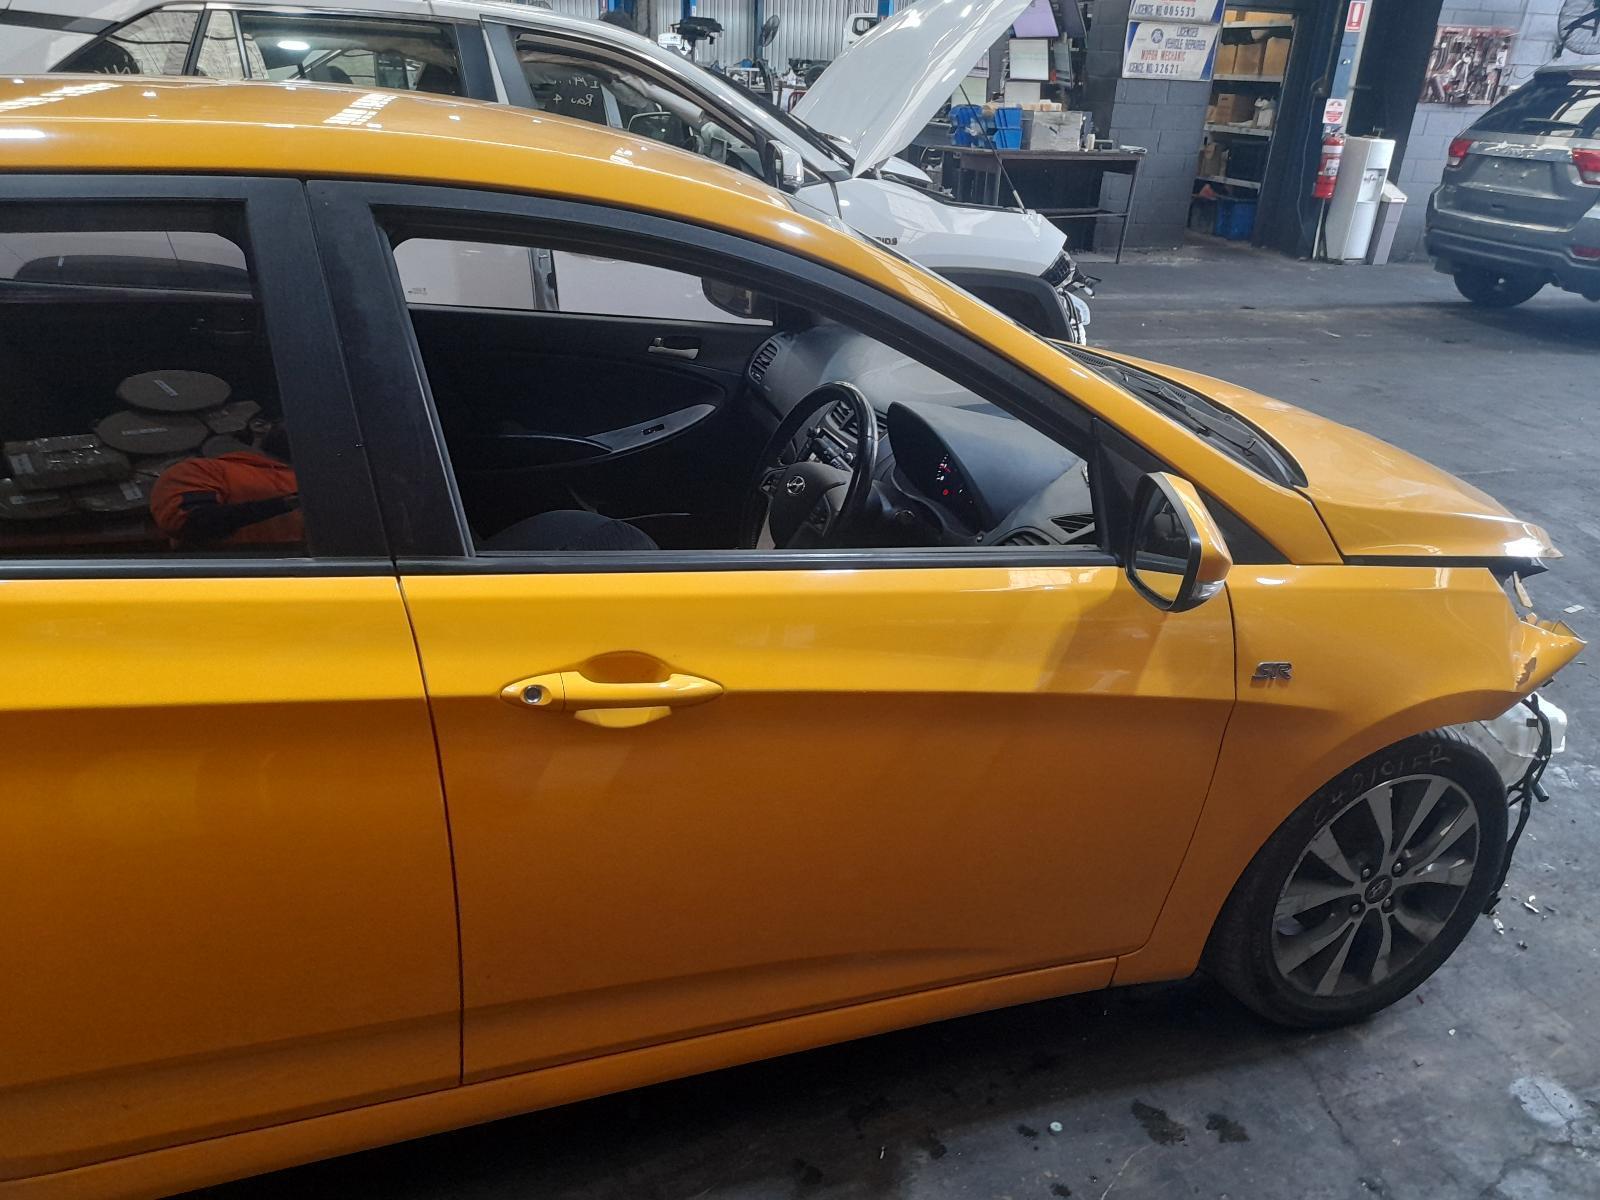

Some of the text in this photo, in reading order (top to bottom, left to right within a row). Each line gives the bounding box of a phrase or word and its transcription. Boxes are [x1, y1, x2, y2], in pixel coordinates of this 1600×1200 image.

[1165, 37, 1183, 49] VEHICLE
[1141, 49, 1186, 62] MOTOR MECHANIC
[1154, 63, 1180, 74] 32621
